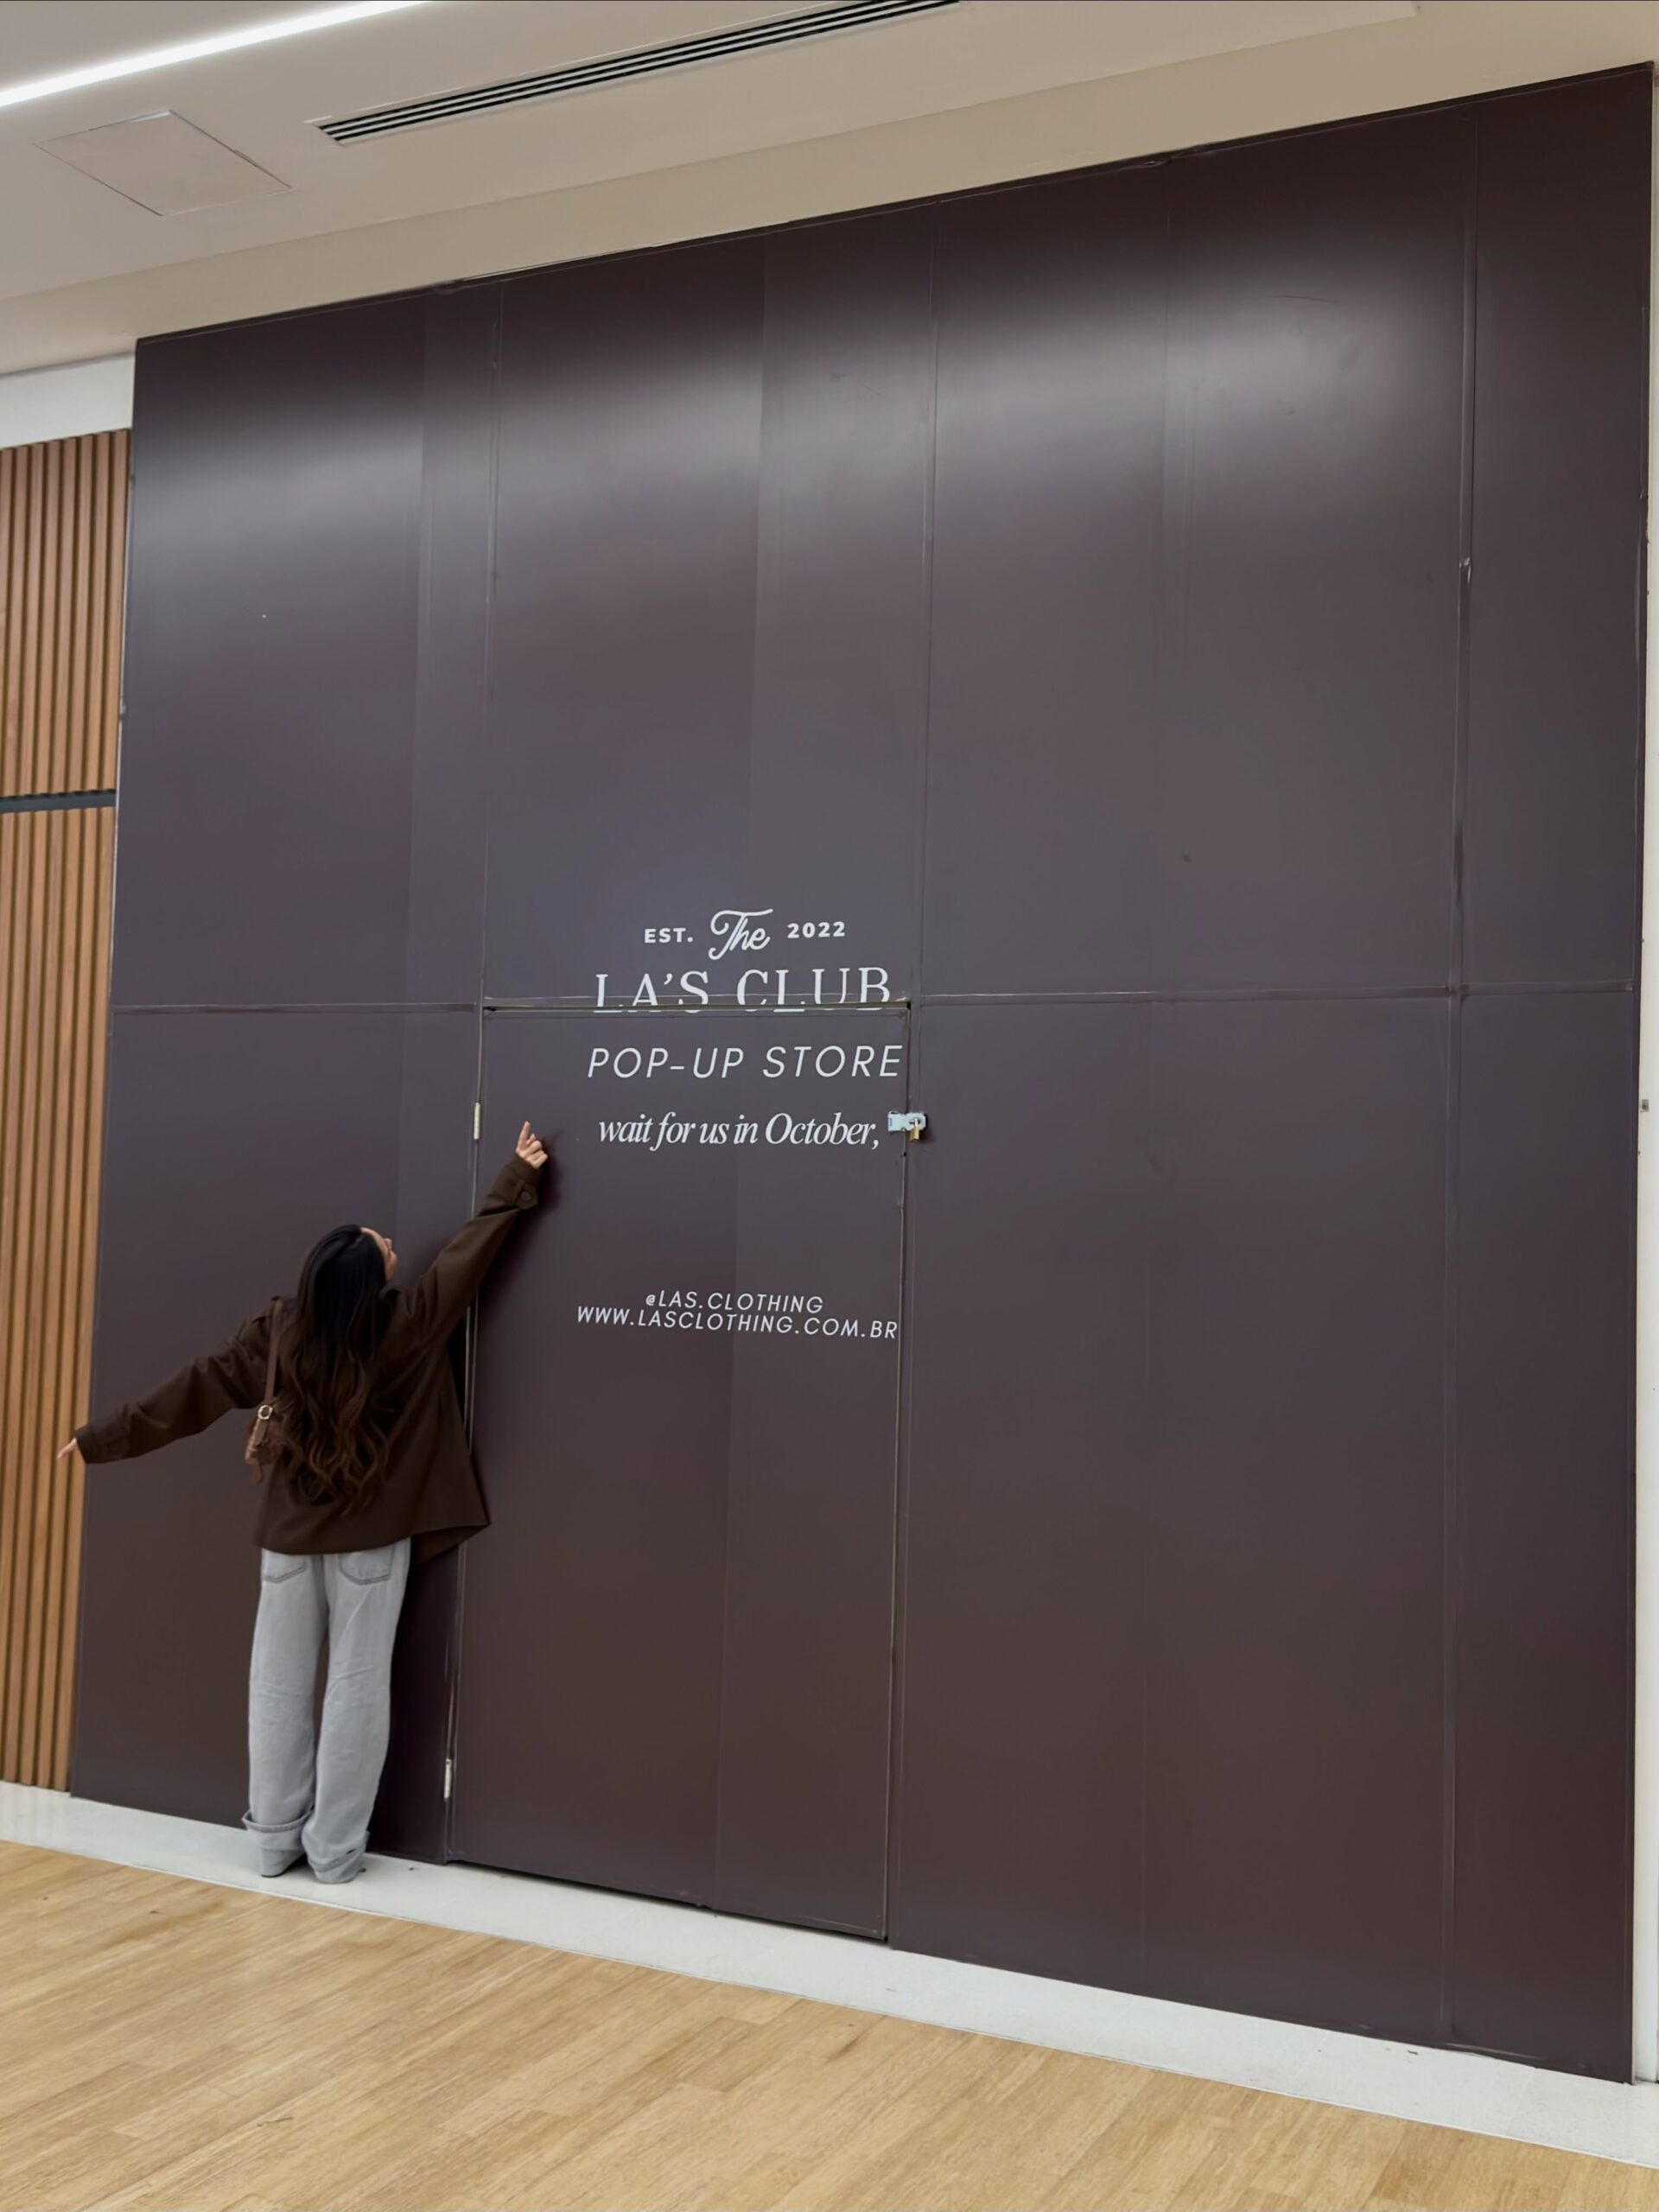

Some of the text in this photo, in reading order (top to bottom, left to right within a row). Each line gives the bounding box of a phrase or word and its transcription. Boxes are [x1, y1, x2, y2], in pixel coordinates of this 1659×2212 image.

[644, 908, 846, 960] EST. The 2022
[736, 966, 891, 1013] CLUB
[588, 1045, 903, 1078] POP-UP STORE
[599, 1111, 880, 1151] wait for us in October,
[645, 1290, 823, 1313] @LAS.CLOTHING
[577, 1306, 898, 1339] WWW.LASCLOTHING.COM.BR
